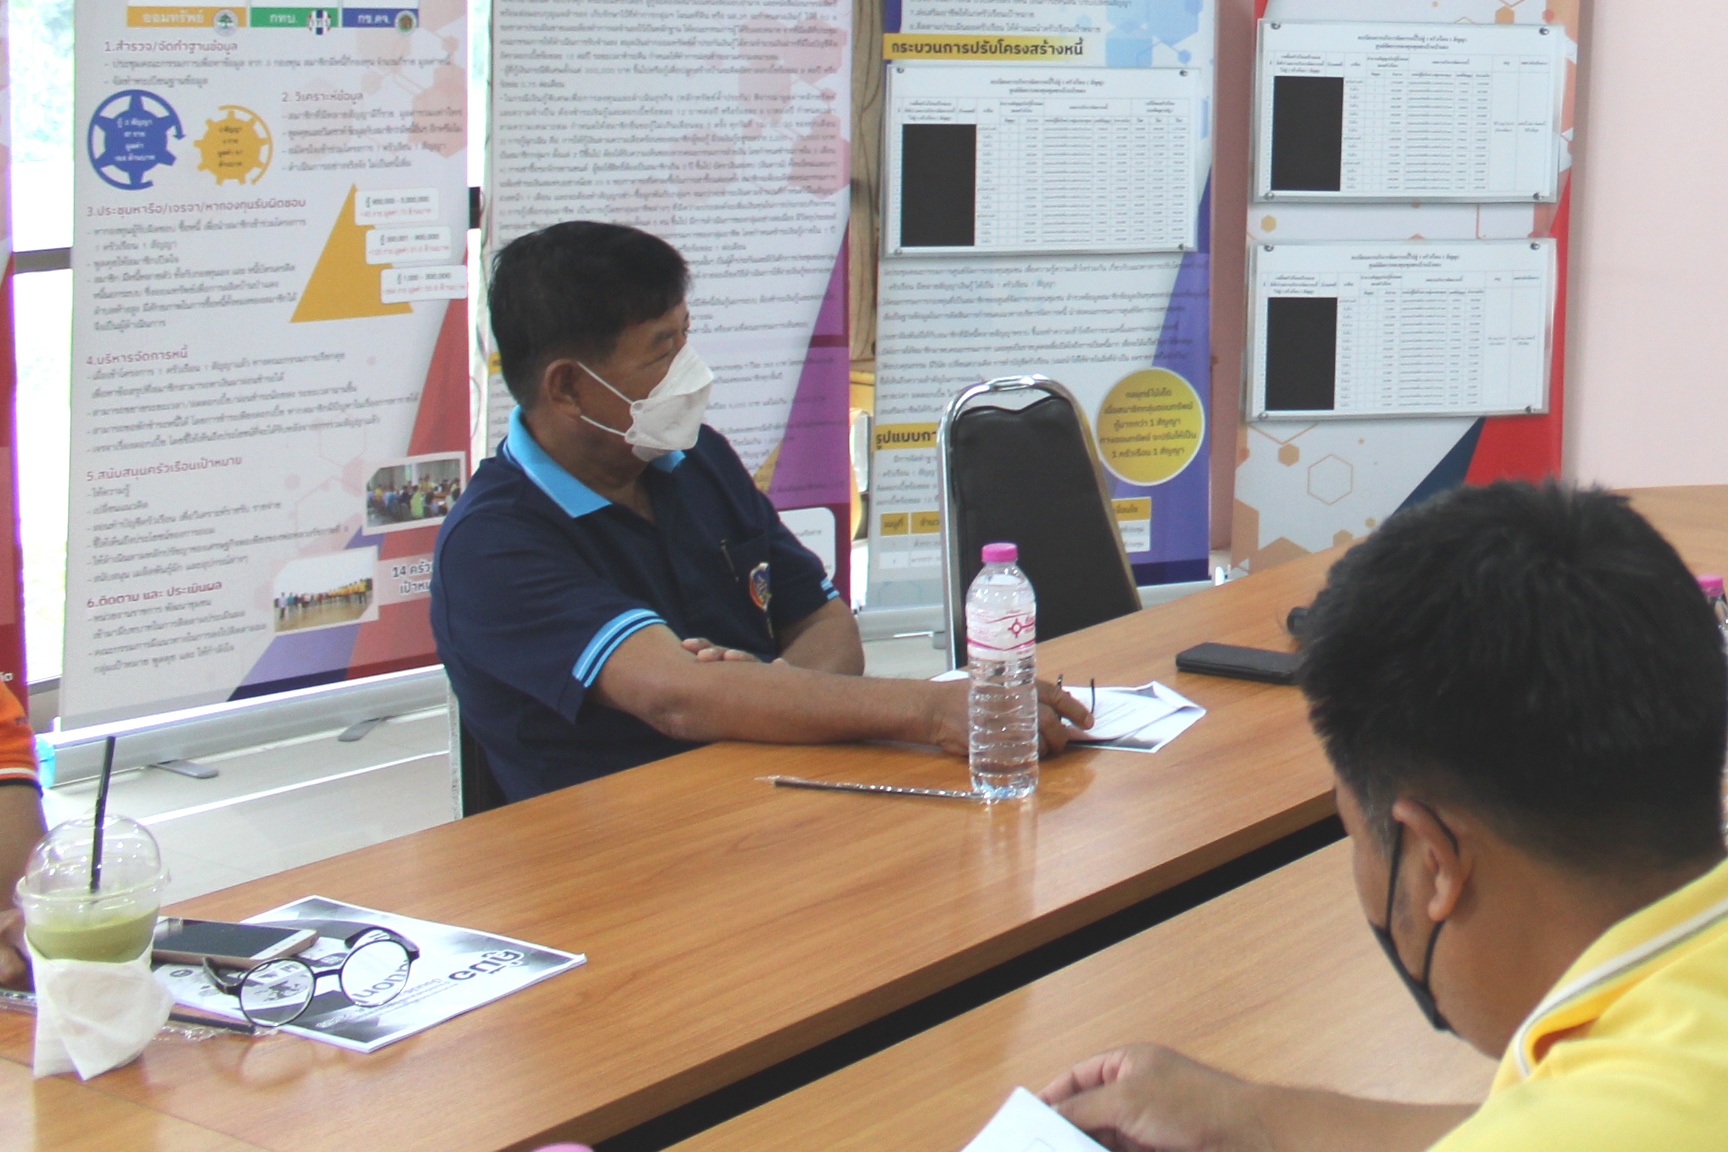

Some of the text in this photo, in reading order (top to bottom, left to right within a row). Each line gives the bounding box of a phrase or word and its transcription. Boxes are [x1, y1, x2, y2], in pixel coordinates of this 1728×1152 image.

[891, 37, 1084, 57] กระบวนการปรับโครงสร้างหนี้
[392, 561, 430, 578] 14 ครัว
